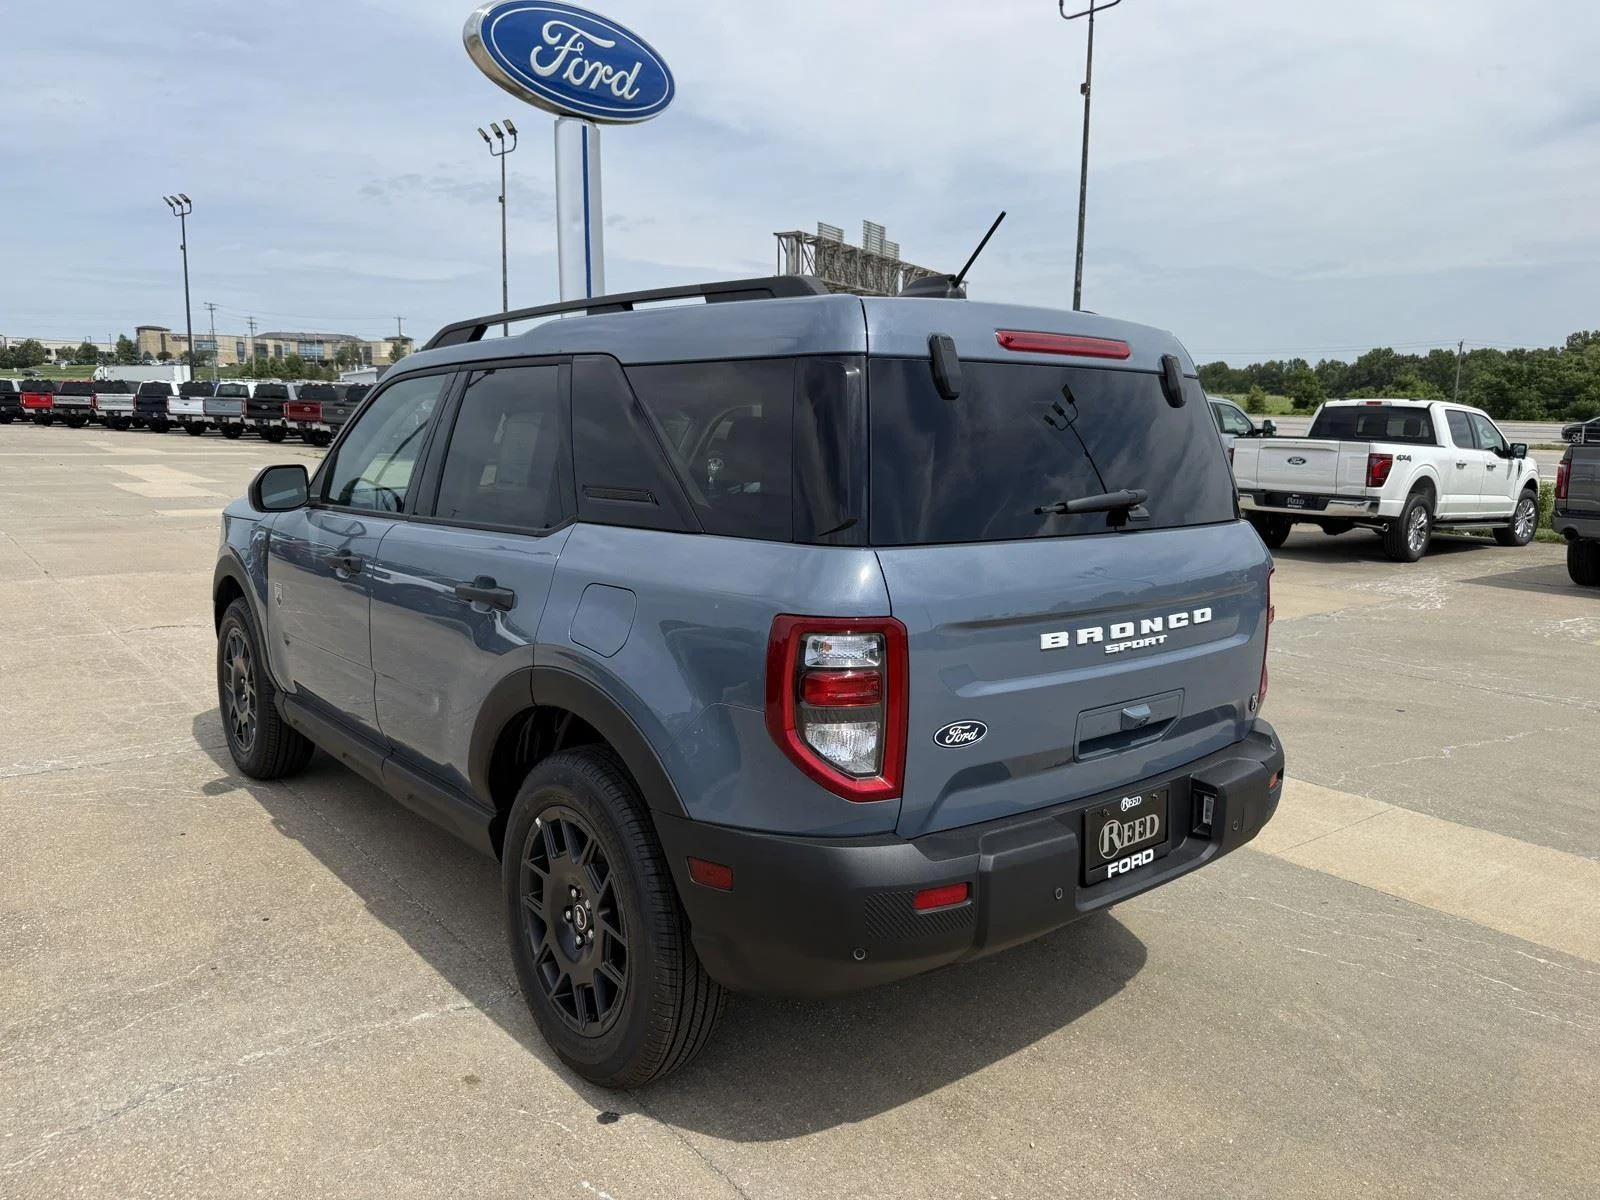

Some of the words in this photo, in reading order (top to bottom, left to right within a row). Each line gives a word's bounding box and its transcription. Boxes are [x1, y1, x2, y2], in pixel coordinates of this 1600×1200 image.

[530, 20, 643, 100] Ford
[1040, 607, 1212, 650] BRONCO
[1105, 634, 1168, 654] SPORT
[945, 724, 979, 744] Ford
[1121, 795, 1142, 811] REED
[1101, 813, 1160, 855] REED
[1107, 848, 1154, 879] FORD
